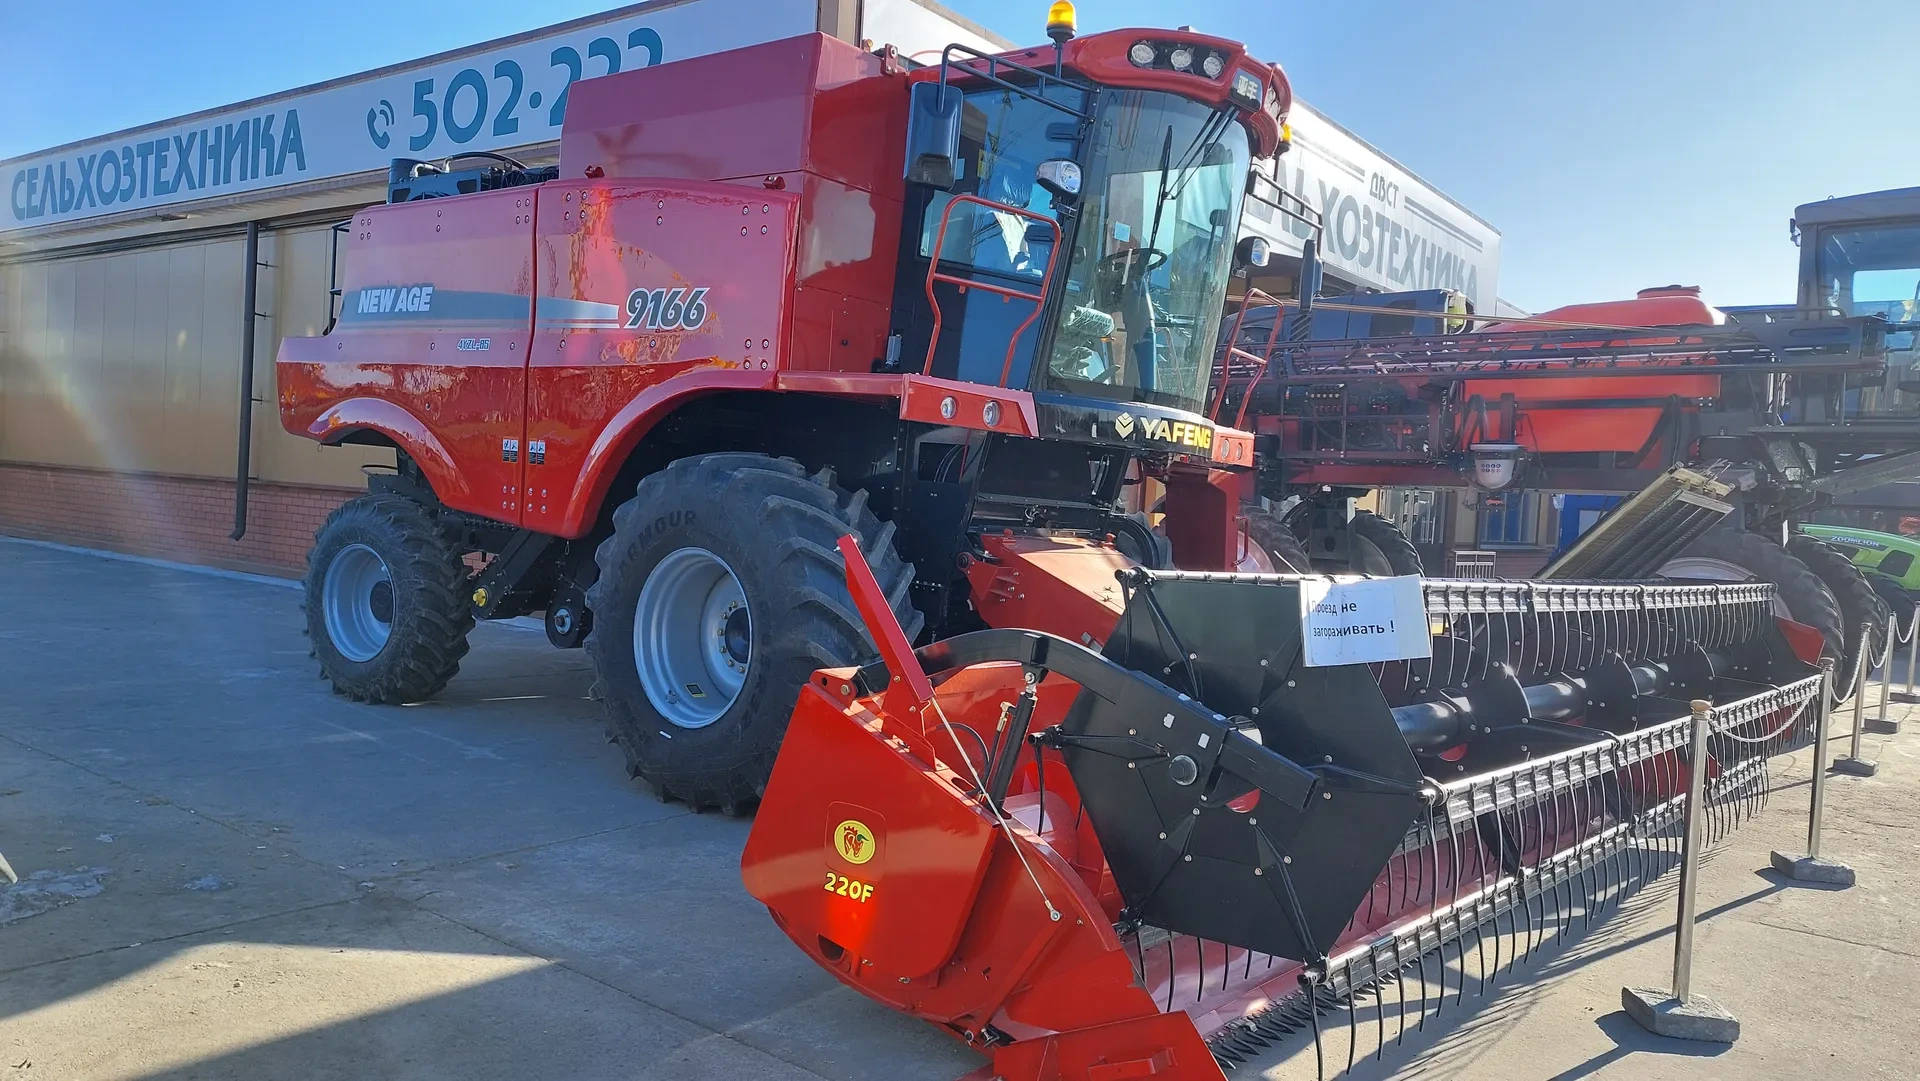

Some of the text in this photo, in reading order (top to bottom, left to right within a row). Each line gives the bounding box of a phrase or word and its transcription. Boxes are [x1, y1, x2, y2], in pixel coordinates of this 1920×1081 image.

[11, 109, 306, 220] СЕЛЬХОЗТЕХНИКА
[1369, 171, 1399, 209] ДВСТ
[358, 286, 433, 313] NEW AGE
[623, 287, 710, 330] 9166
[1140, 417, 1211, 448] YAFENG
[1831, 536, 1879, 547] ZOOMLION
[1312, 600, 1358, 616] Проезд не
[1313, 624, 1385, 640] загораживать
[824, 872, 873, 903] 220F
